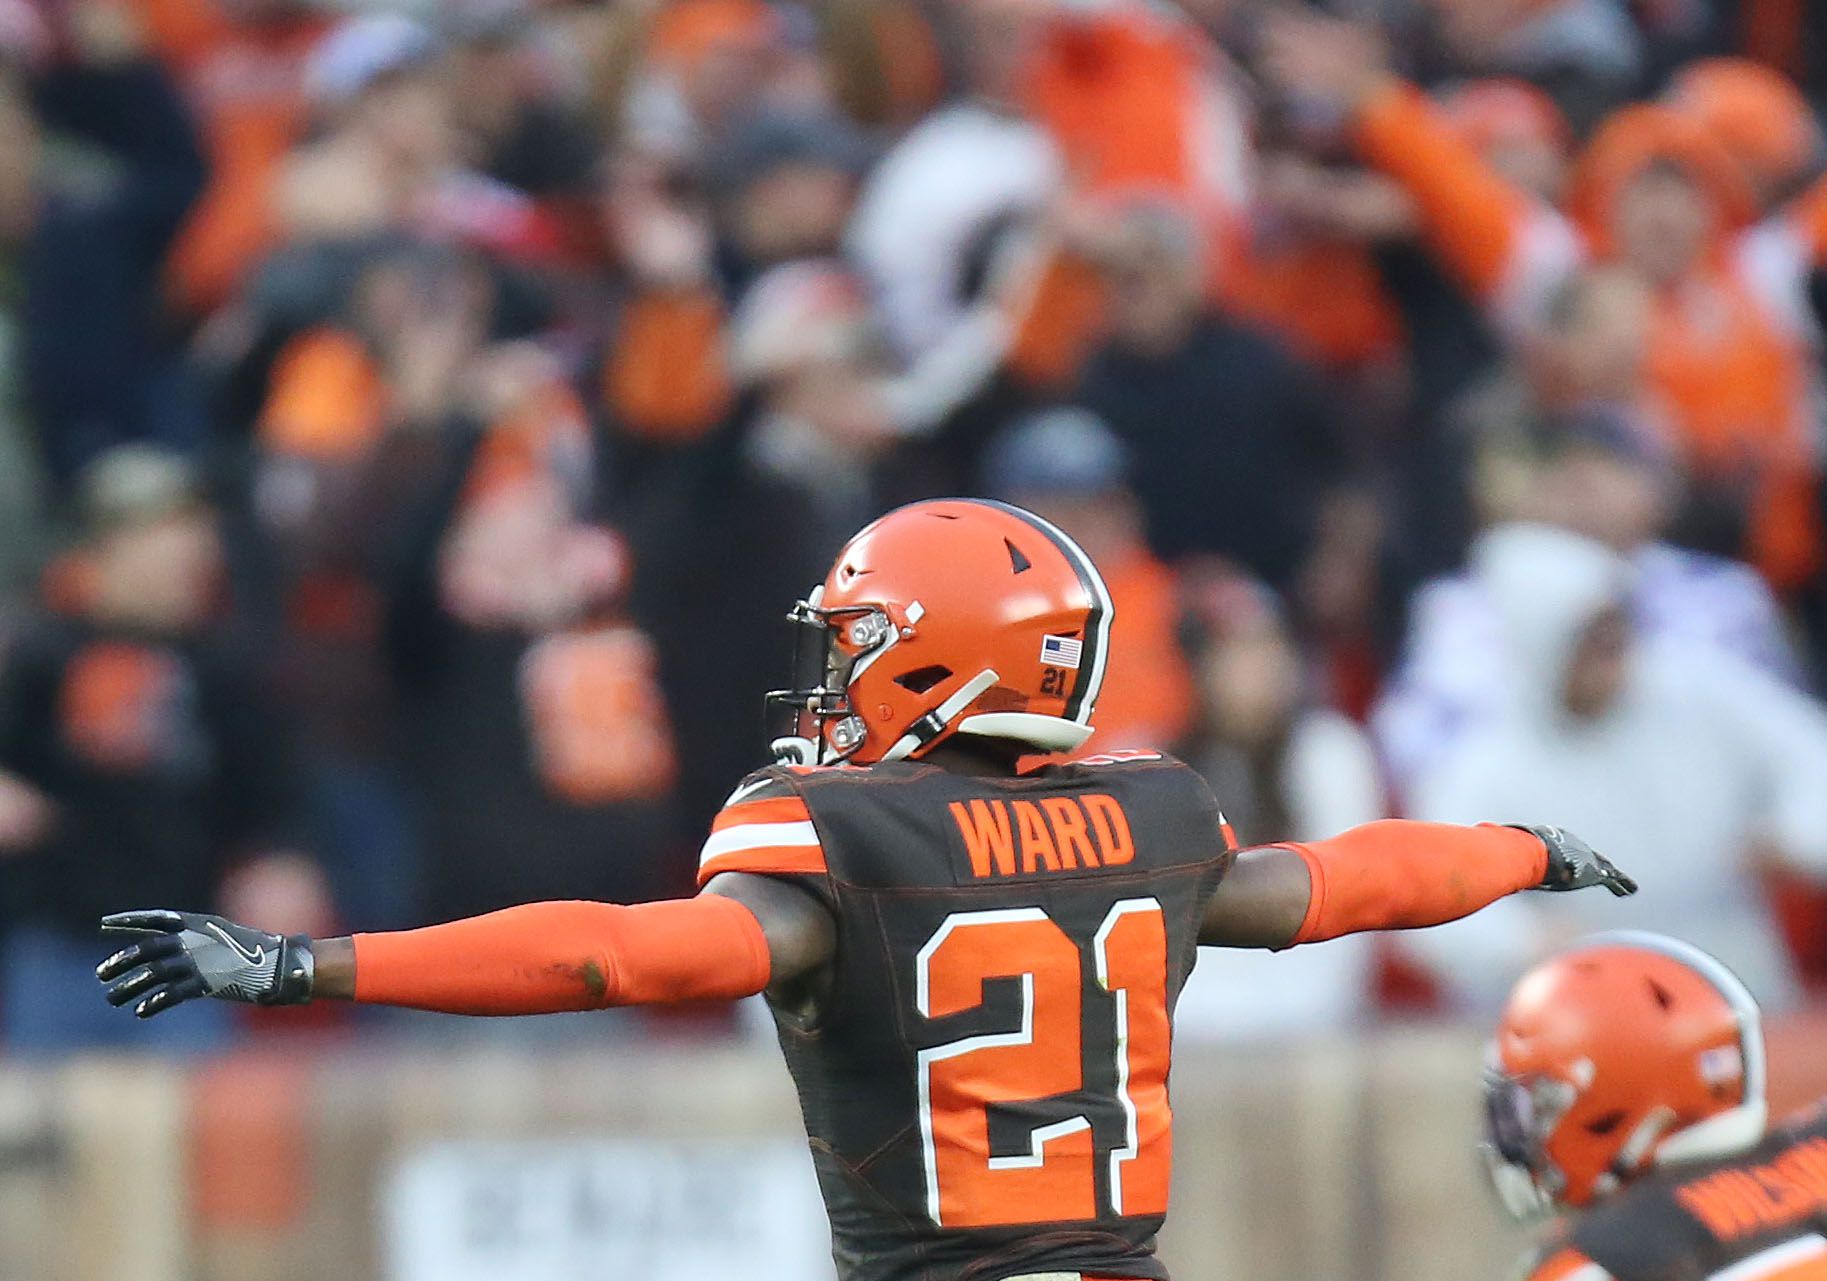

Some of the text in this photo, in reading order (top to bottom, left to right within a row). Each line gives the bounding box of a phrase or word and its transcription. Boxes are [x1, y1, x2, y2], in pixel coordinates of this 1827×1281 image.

[1040, 667, 1067, 697] 21
[948, 793, 1136, 879] WARD
[917, 896, 1173, 1229] 21
